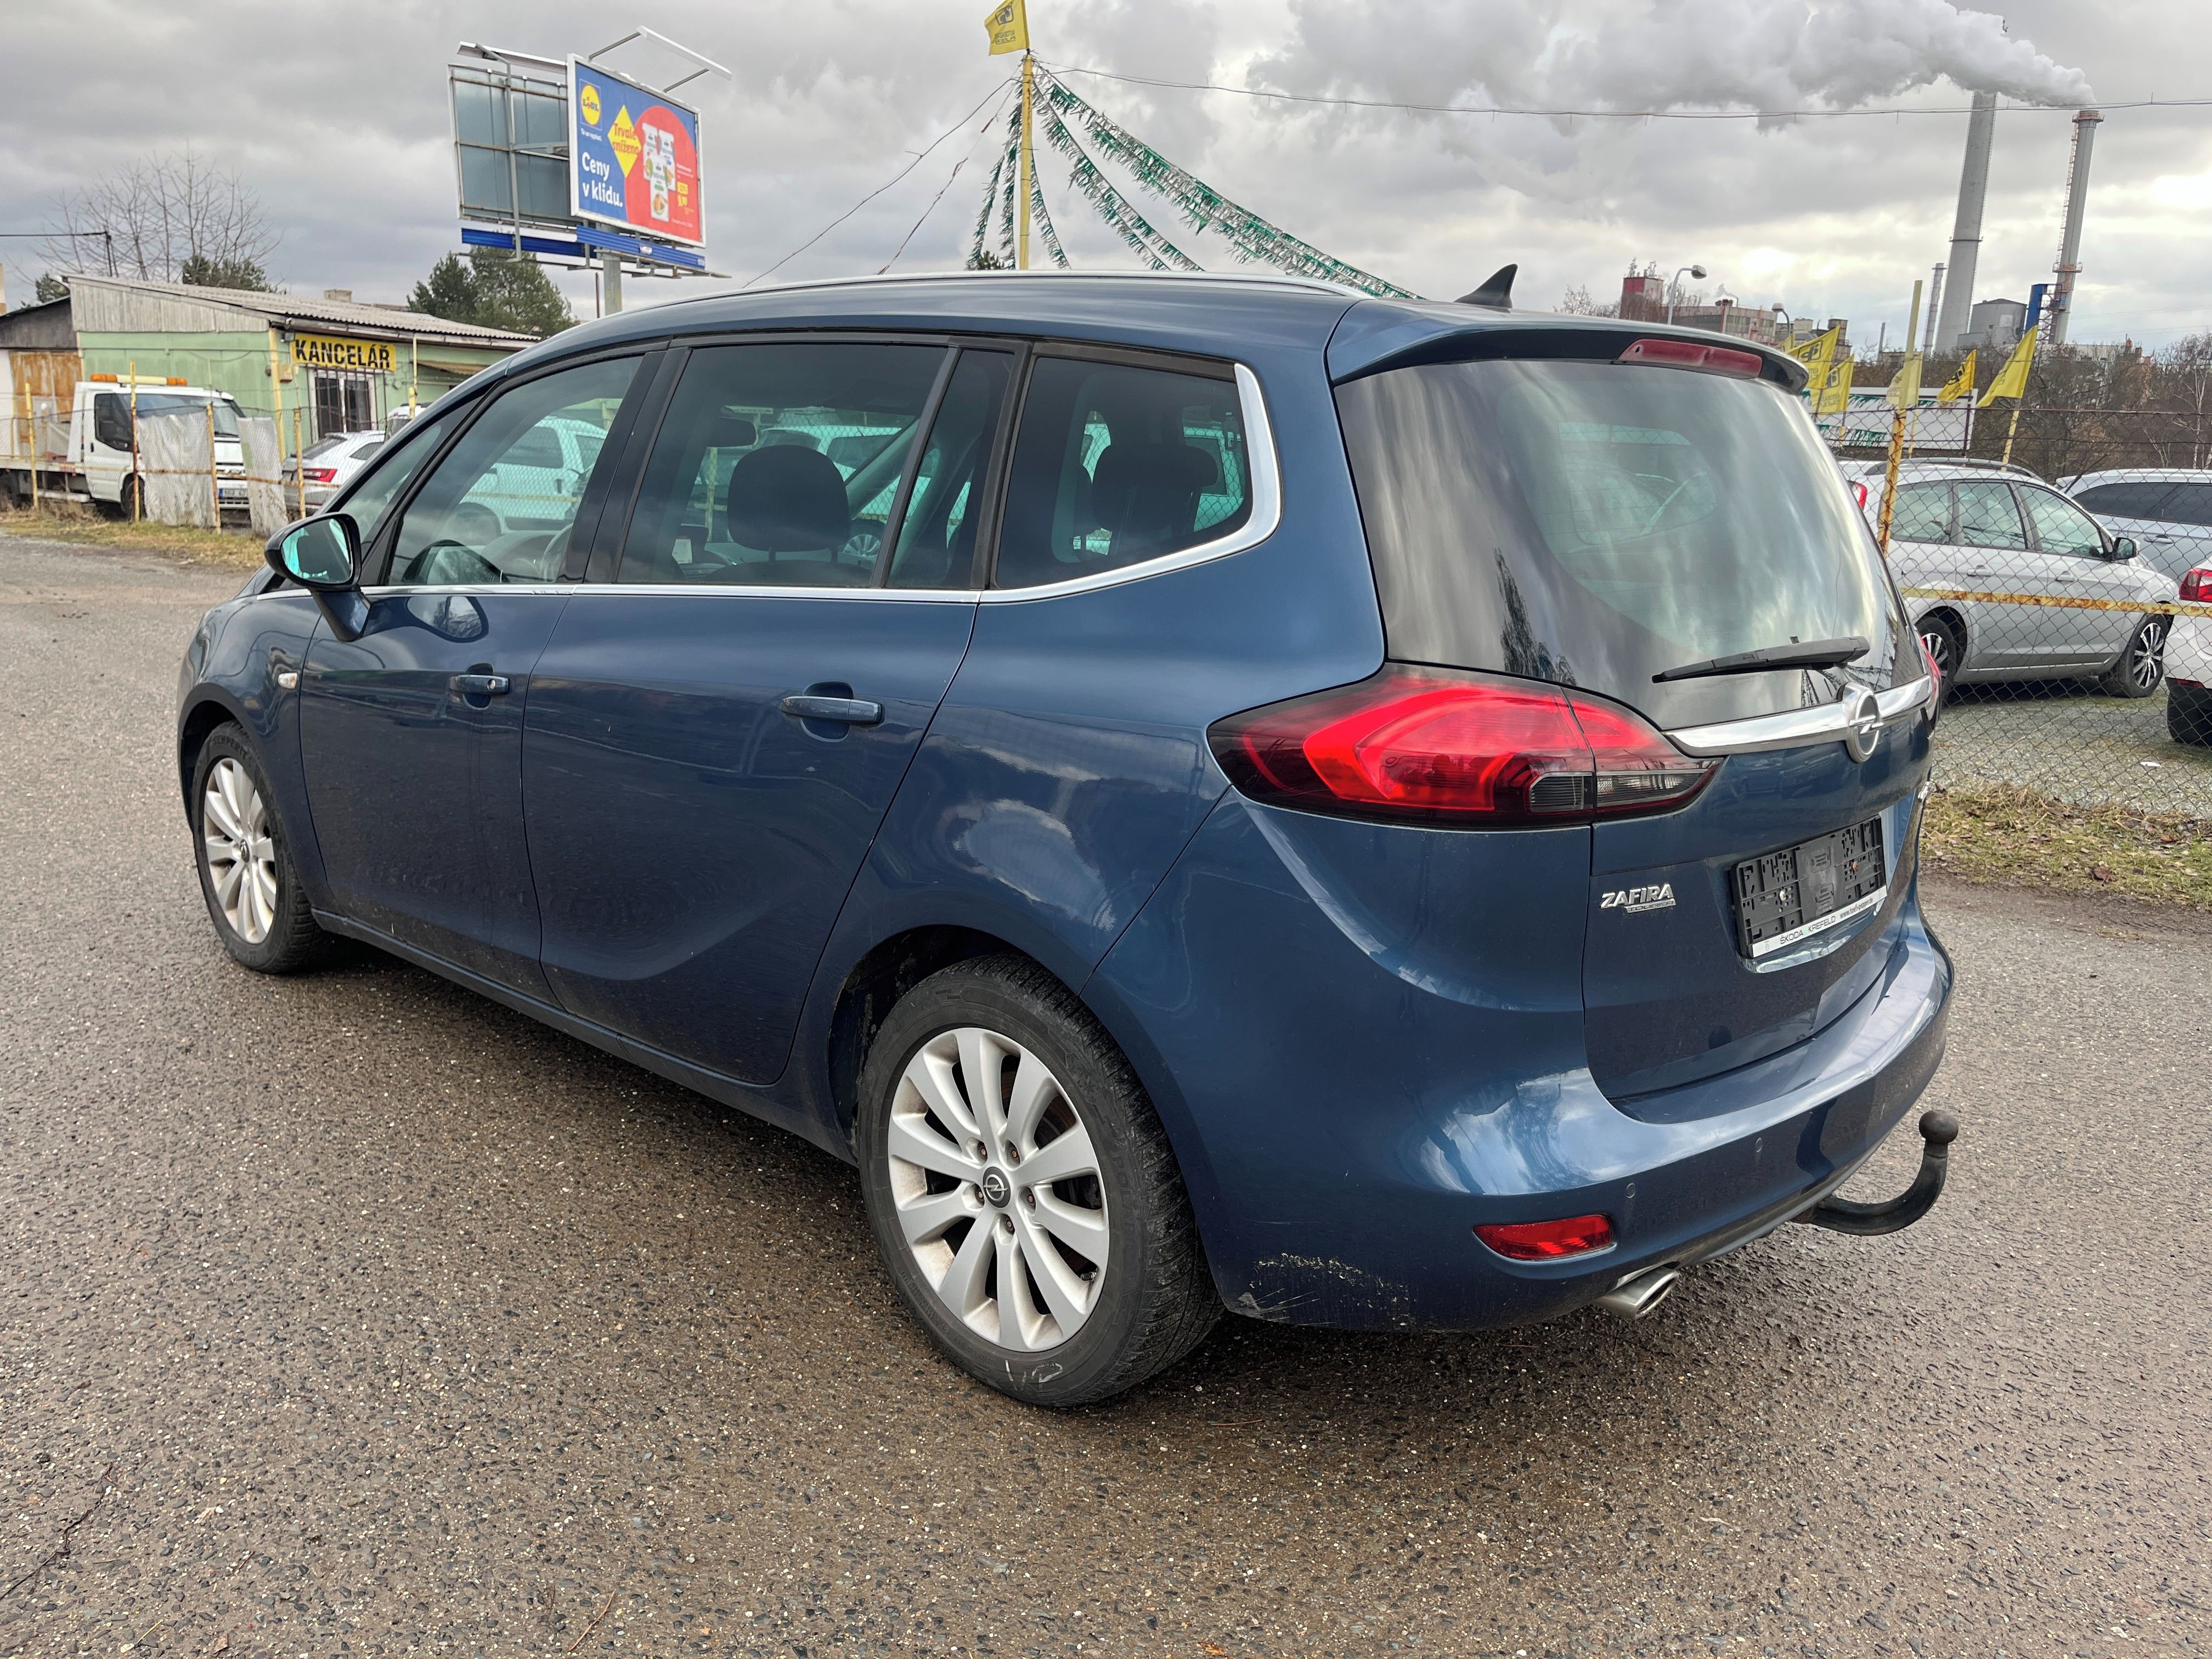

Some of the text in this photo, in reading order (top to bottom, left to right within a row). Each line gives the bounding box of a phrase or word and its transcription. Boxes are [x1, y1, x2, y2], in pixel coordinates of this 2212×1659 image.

[582, 151, 610, 182] Ceny
[582, 180, 624, 207] v klidu.
[295, 338, 390, 370] KANCELÁŘ
[1599, 883, 1674, 910] ZAFIRA
[1627, 900, 1674, 912] TOURER
[1780, 929, 1804, 945] ŠKODA
[1808, 915, 1836, 934] KREFELD
